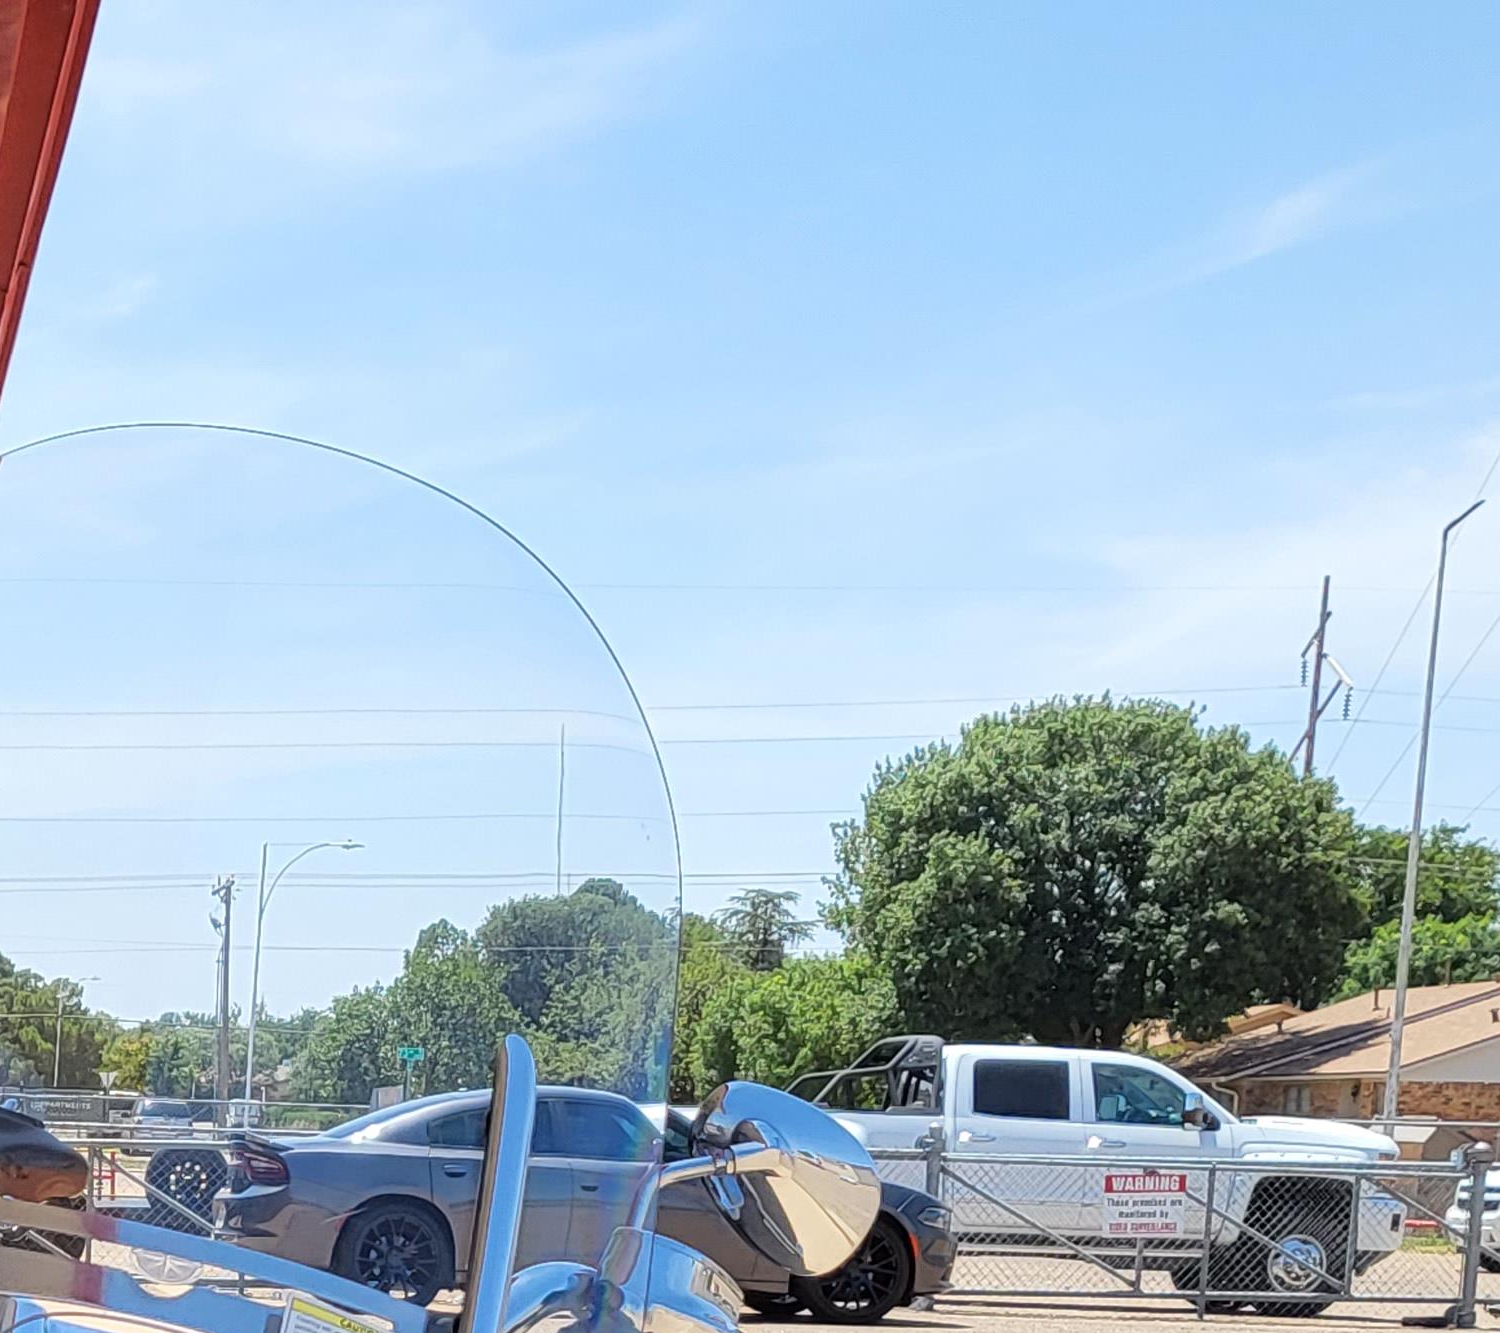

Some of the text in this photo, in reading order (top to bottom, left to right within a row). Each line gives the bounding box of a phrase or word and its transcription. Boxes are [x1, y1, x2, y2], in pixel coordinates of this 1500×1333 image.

[1111, 1176, 1180, 1191] WARNING
[1170, 1198, 1183, 1206] are
[1159, 1210, 1169, 1219] by
